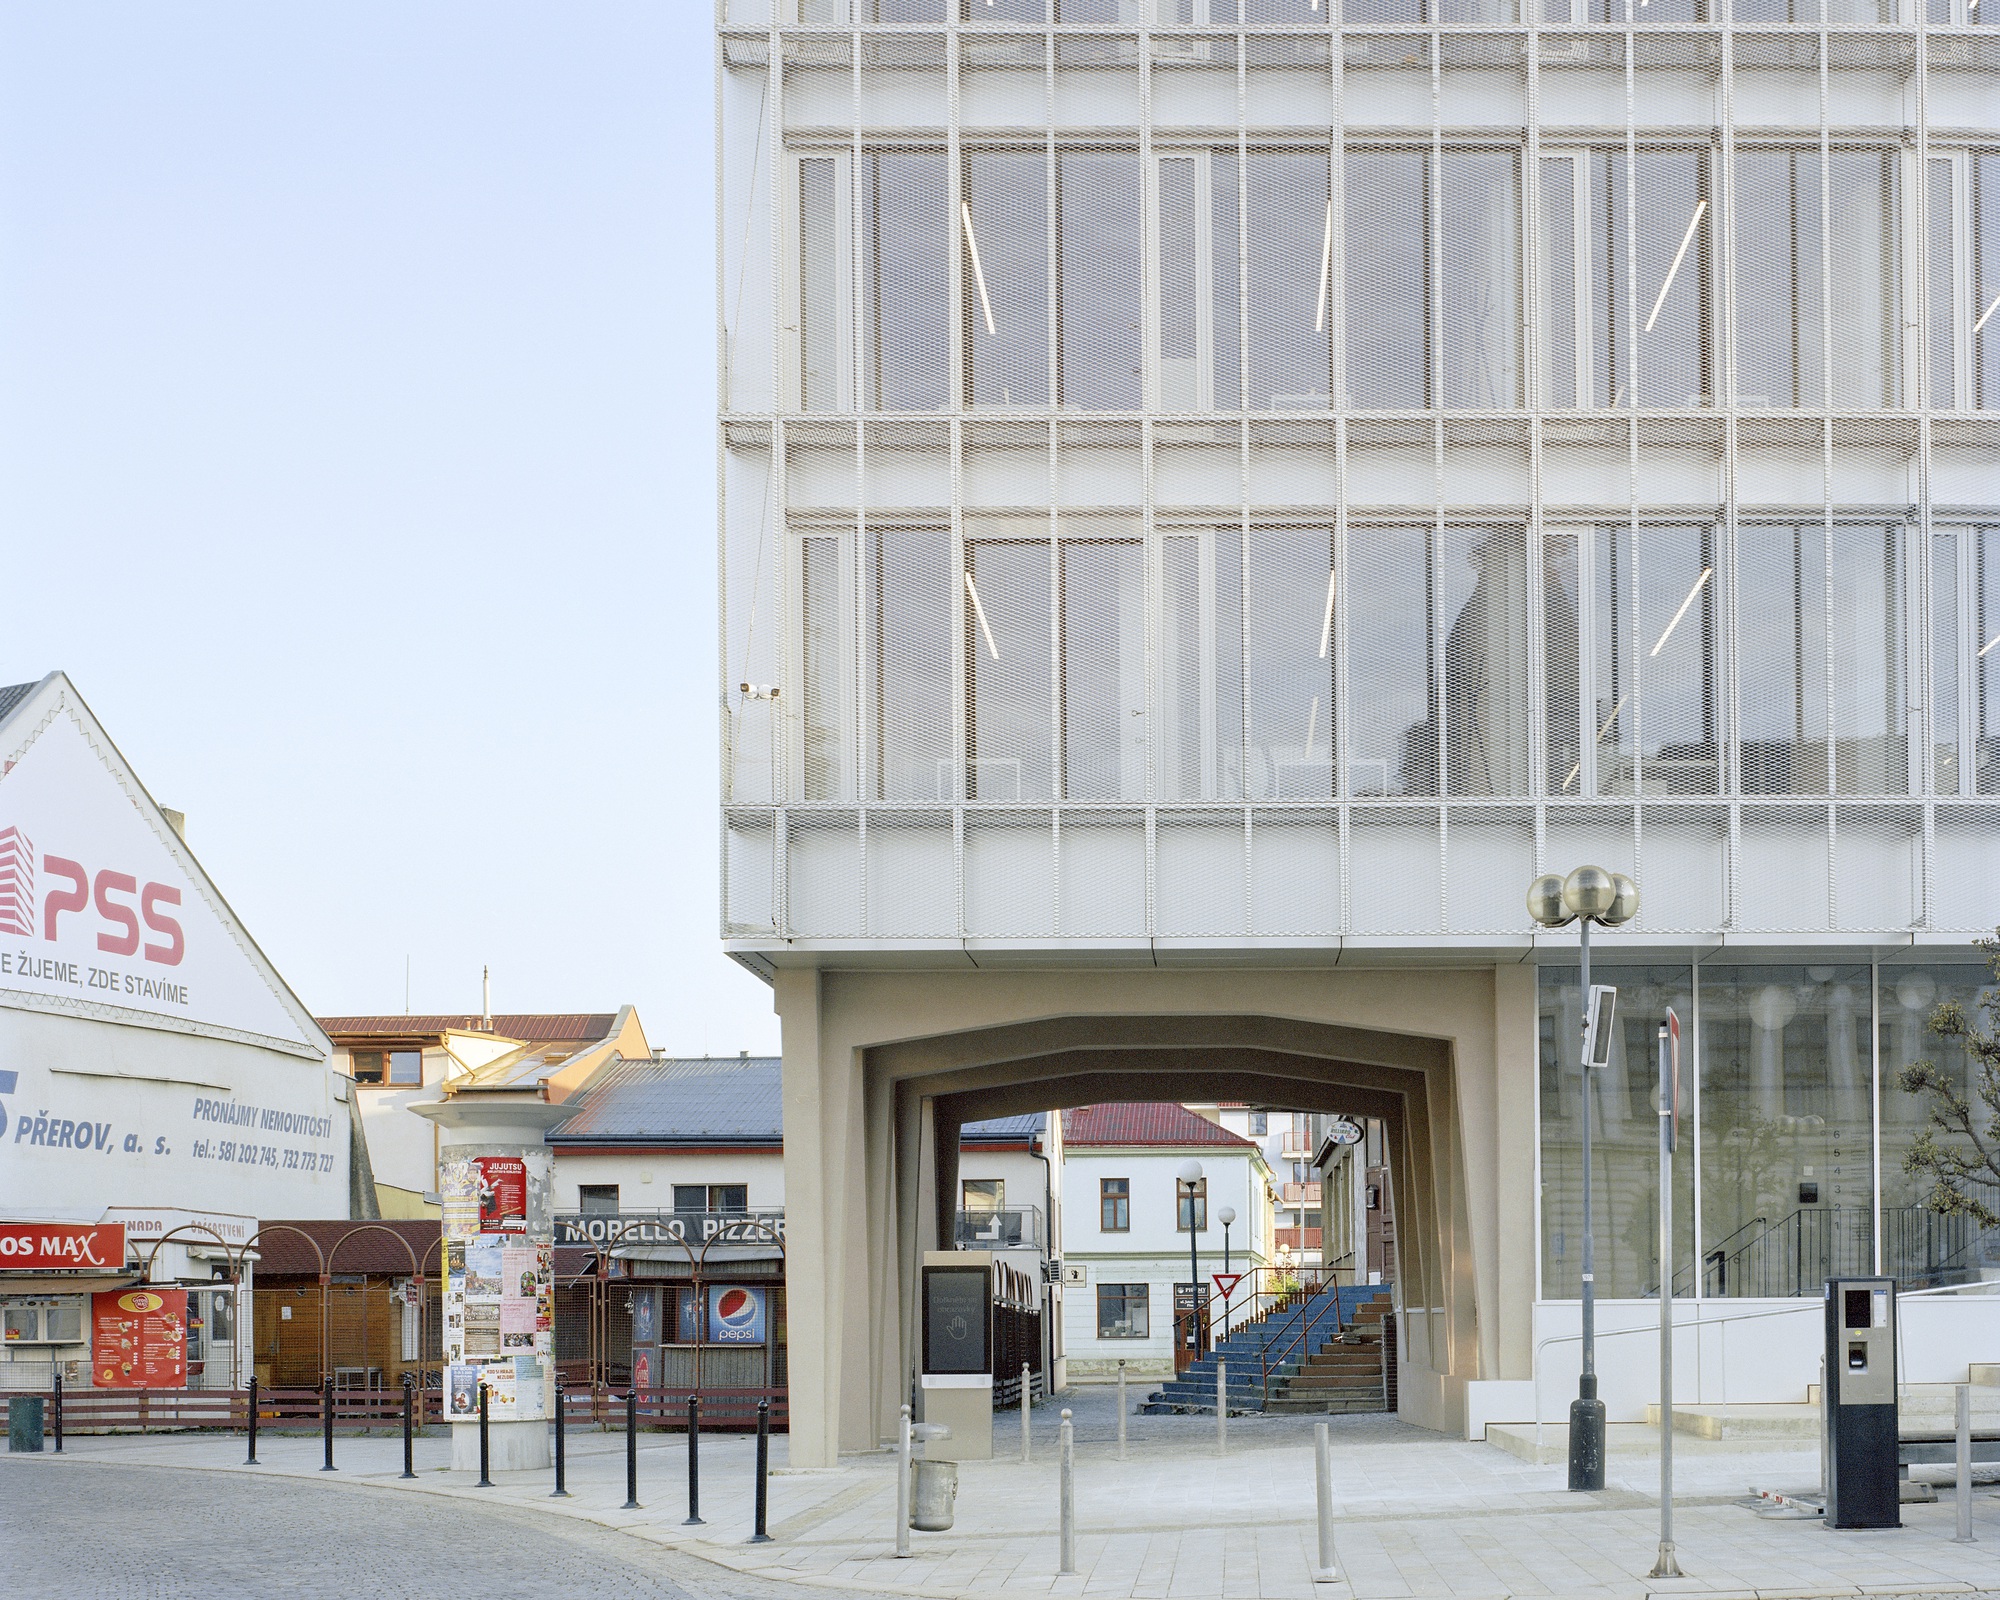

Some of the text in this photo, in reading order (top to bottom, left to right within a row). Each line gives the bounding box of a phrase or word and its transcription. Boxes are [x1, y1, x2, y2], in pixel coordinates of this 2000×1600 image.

[43, 854, 185, 966] PSS
[17, 950, 83, 988] ŽIJEME,
[87, 967, 120, 991] ZDE
[124, 974, 189, 1005] STAVÍME
[15, 1110, 171, 1155] PŘEROV, a. s.
[193, 1098, 332, 1138] PRONÁJMY NEMOVITOSTÍ
[218, 1141, 237, 1162] 581
[238, 1143, 258, 1164] 202
[259, 1146, 279, 1170] 745,
[282, 1149, 300, 1169] 732
[300, 1151, 318, 1171] 773
[318, 1153, 335, 1173] 727
[489, 1162, 523, 1171] JUJUTSU
[565, 1219, 686, 1242] MORELLO
[0, 1231, 105, 1266] OS MAX
[718, 1329, 755, 1341] pepsi
